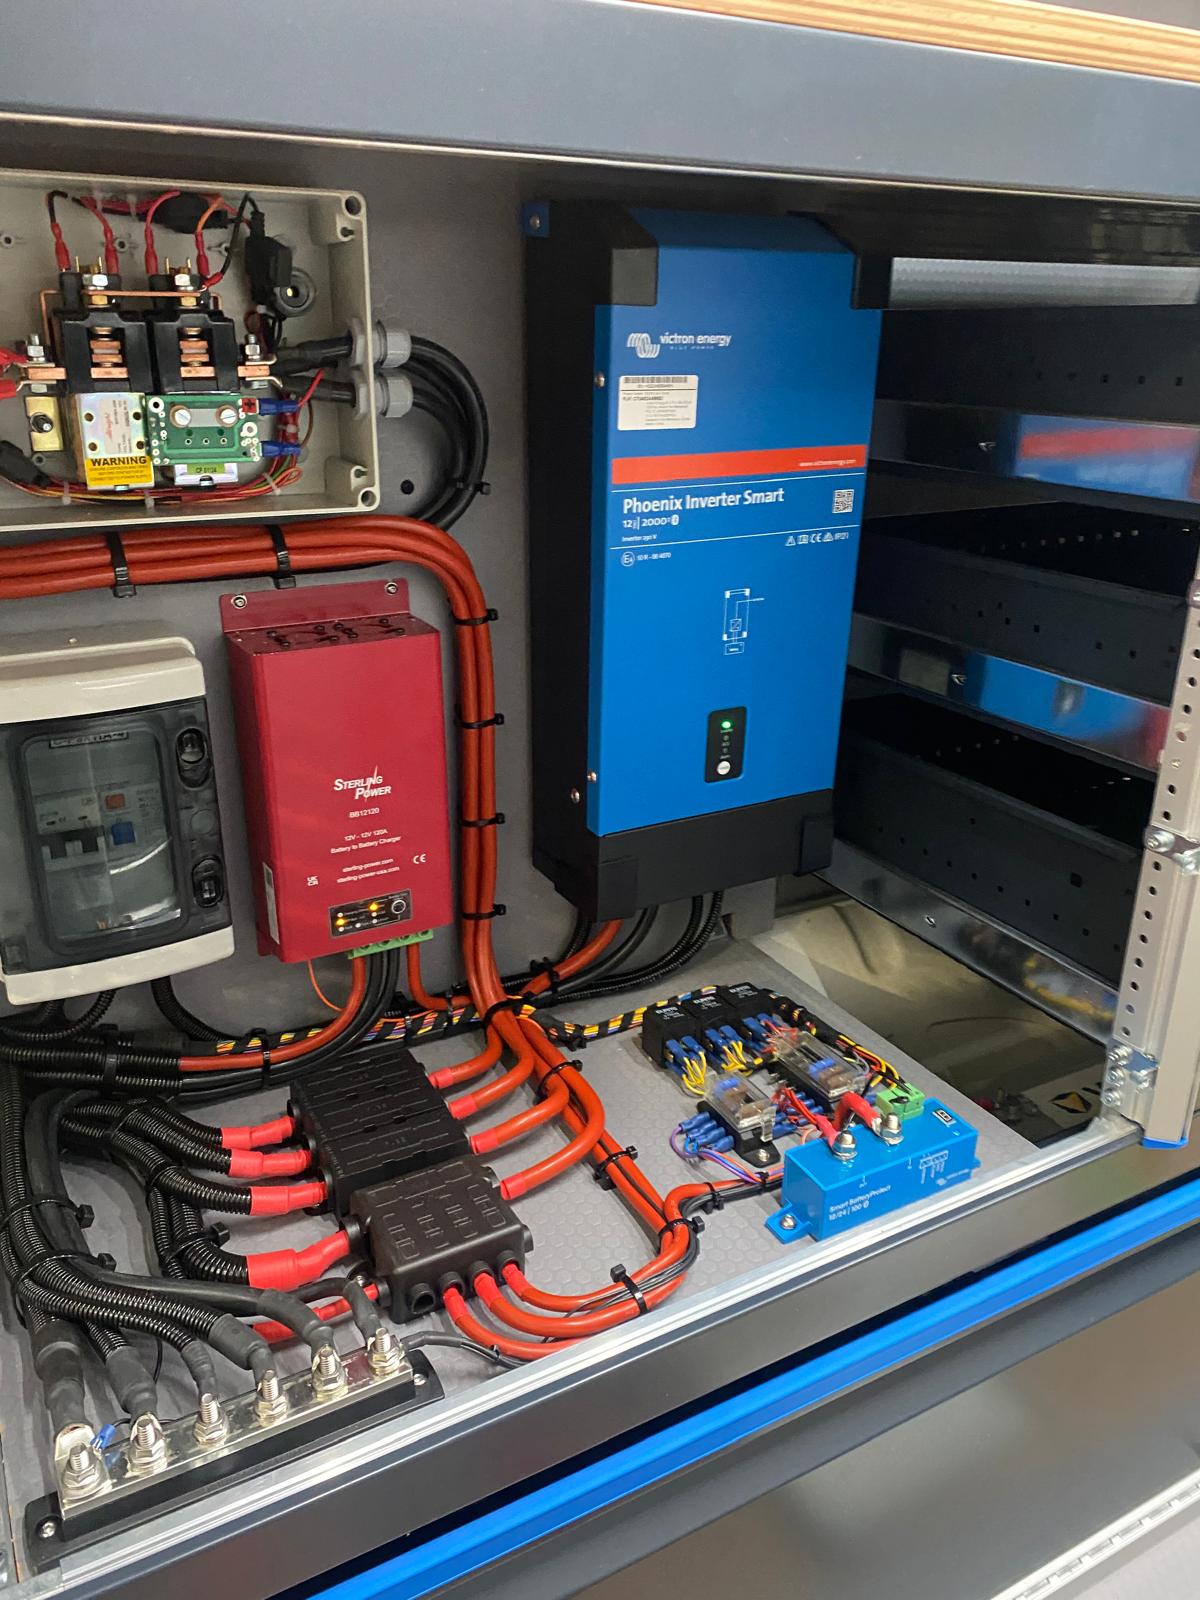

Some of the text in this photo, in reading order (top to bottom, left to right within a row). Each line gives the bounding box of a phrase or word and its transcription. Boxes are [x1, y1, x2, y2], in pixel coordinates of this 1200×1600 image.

[660, 332, 731, 347] victron energy
[91, 456, 147, 467] WARNING
[623, 488, 784, 514] Phoenix Inverter Smart
[333, 775, 383, 791] STERLING
[355, 786, 391, 800] POWER
[349, 807, 379, 818] BB12120
[373, 829, 388, 837] 120A
[331, 846, 351, 854] Battery
[359, 839, 378, 849] Battery
[379, 836, 401, 844] Charger
[413, 853, 426, 864] CE
[829, 1200, 848, 1213] Smart
